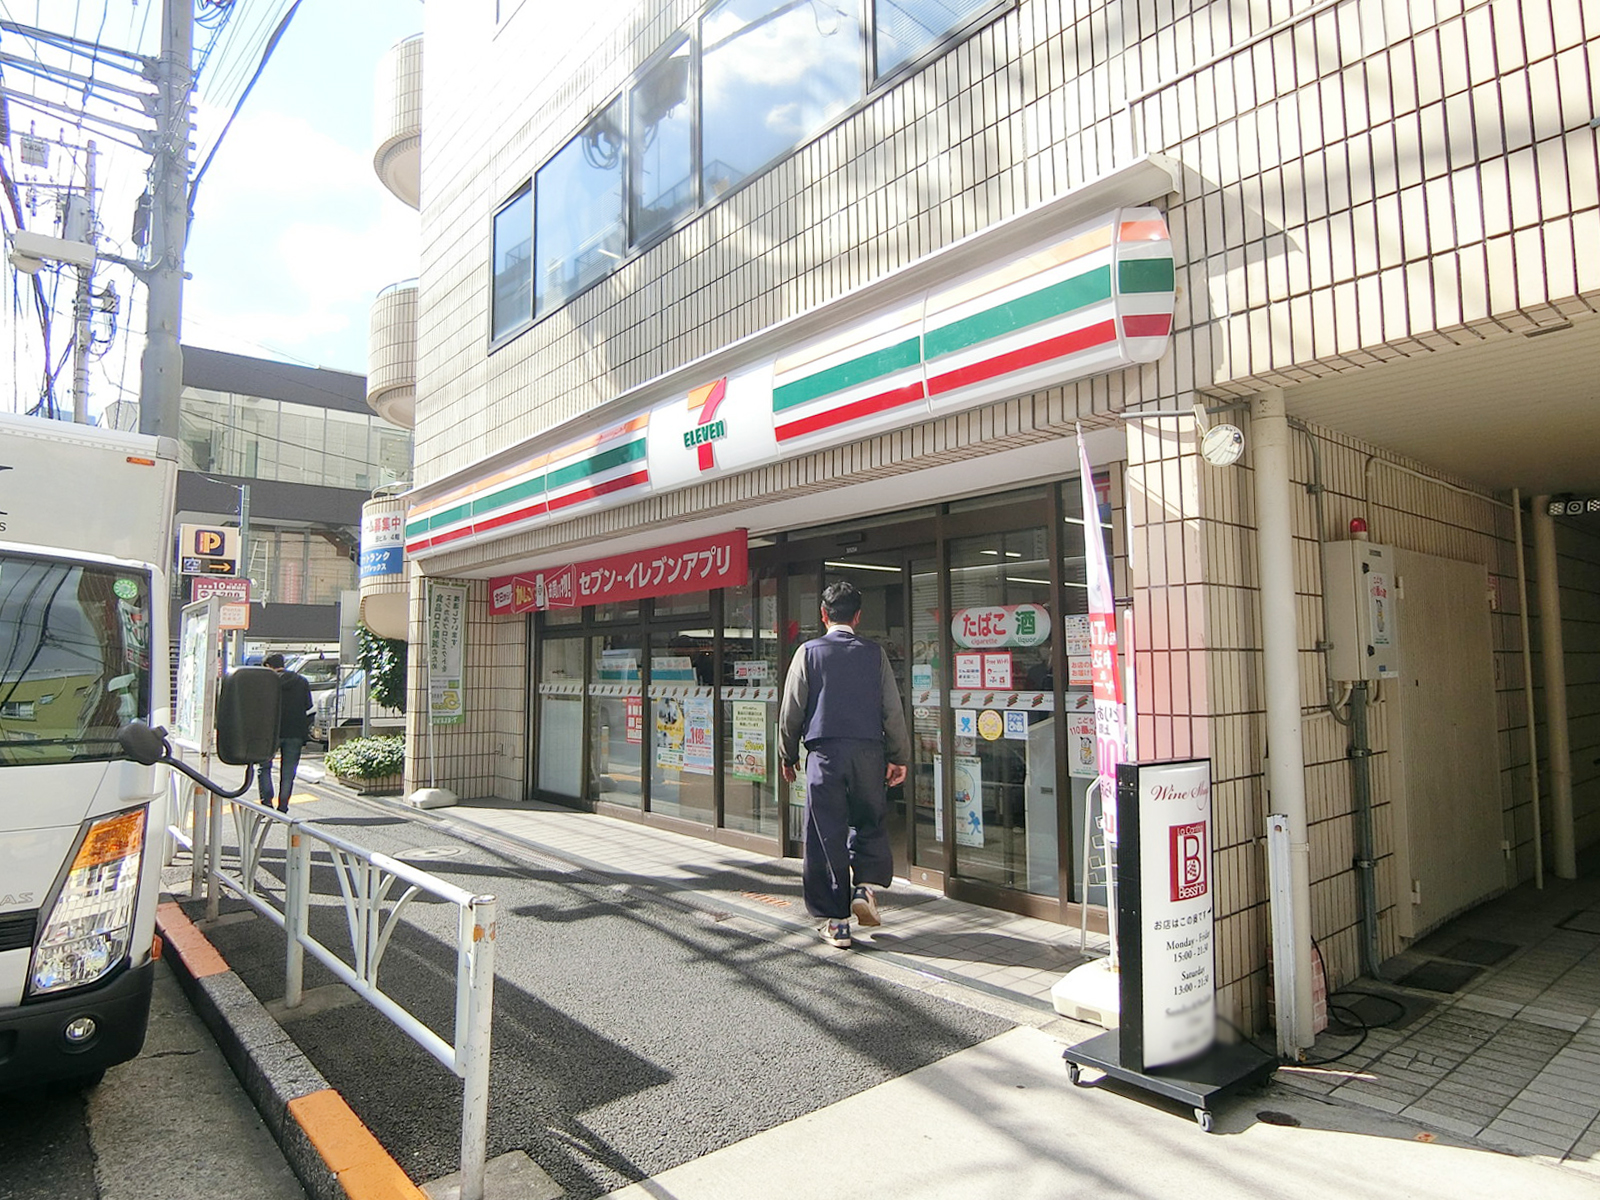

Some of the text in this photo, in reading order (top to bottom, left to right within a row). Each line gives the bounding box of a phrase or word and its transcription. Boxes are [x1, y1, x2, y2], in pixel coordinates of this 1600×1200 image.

[962, 610, 1036, 637] たばこ 酒
[971, 636, 1037, 646] cigarette liquor
[1150, 783, 1190, 802] Wine
[1166, 938, 1195, 951] Monday
[1173, 949, 1193, 963] 15:00
[1181, 966, 1206, 981] Saturday
[1173, 982, 1194, 997] 13:00
